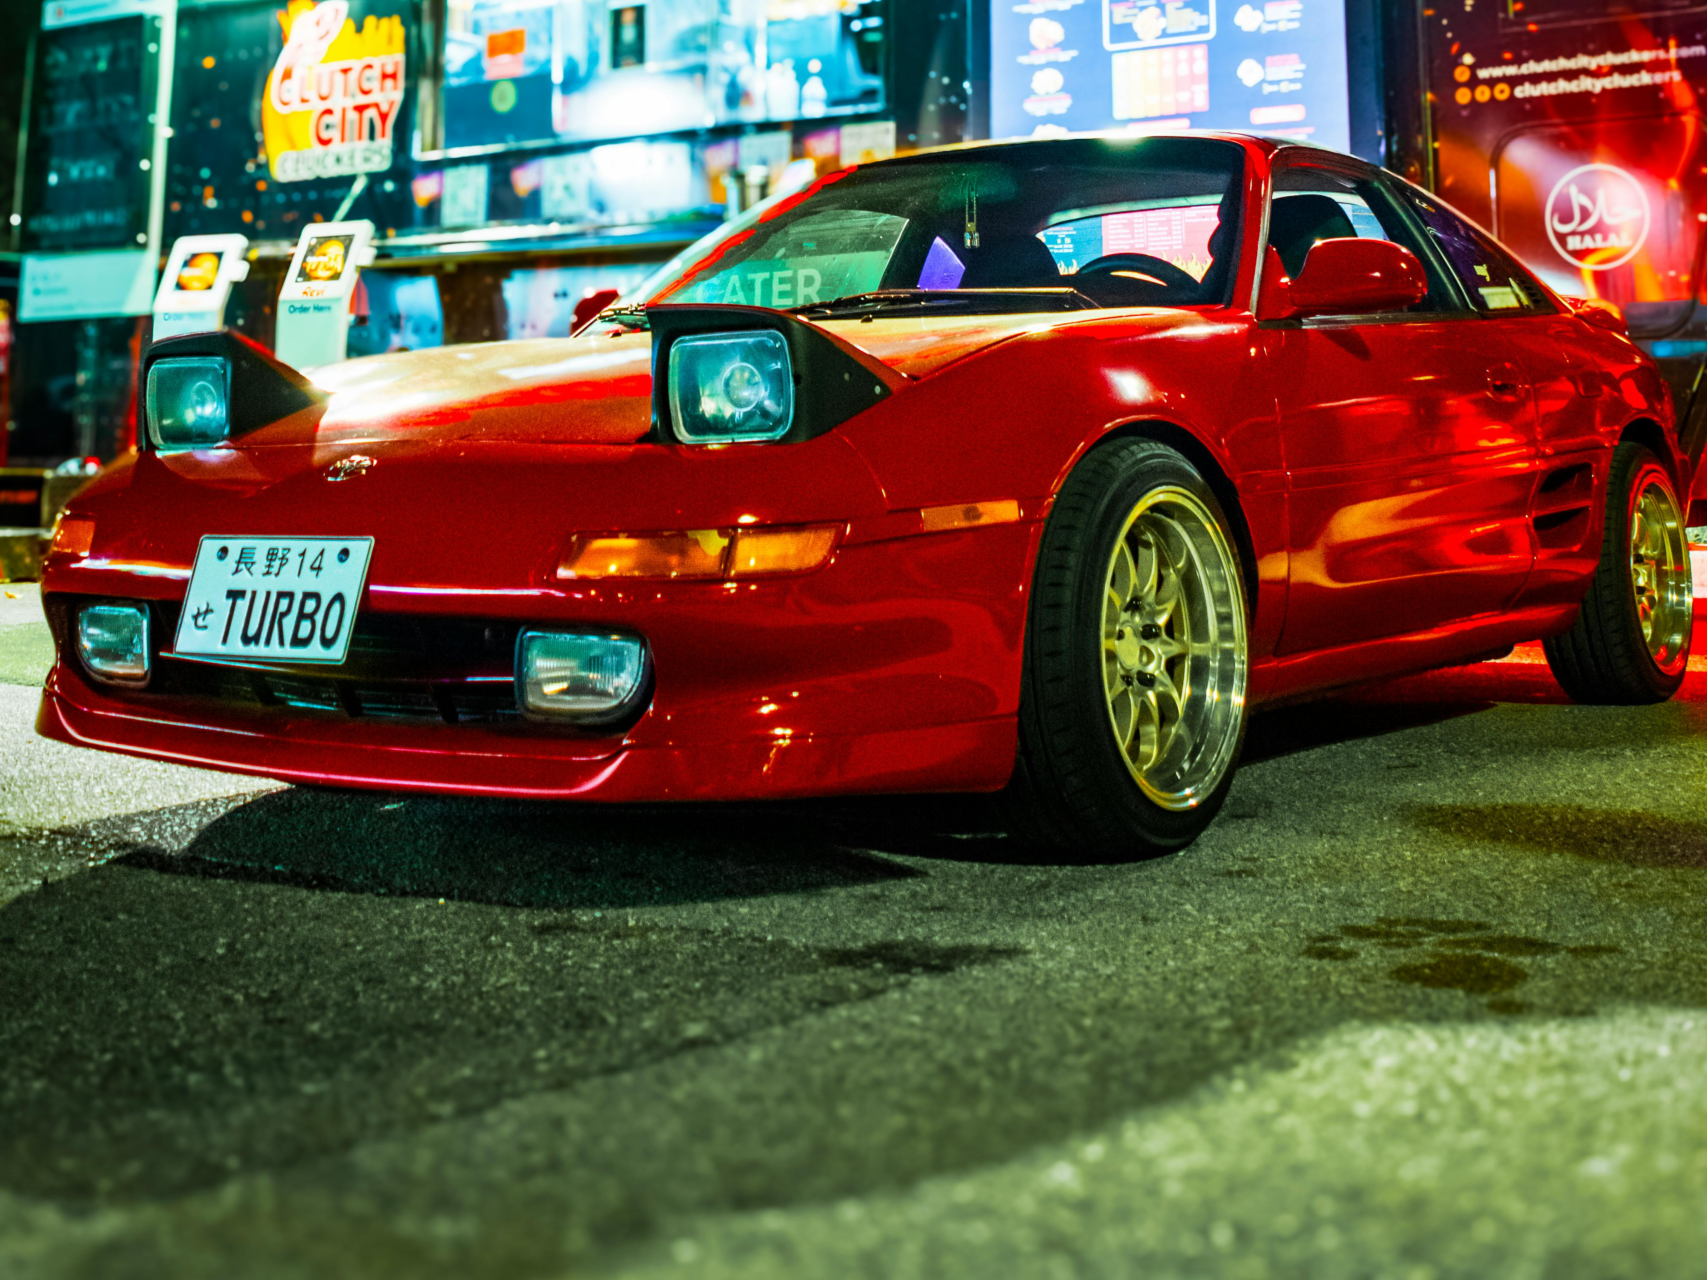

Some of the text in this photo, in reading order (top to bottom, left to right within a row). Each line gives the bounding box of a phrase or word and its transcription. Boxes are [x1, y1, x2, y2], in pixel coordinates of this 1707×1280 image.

[278, 60, 401, 106] CLUTCH
[1476, 45, 1706, 80] www.clutchcitycluckers.com
[1513, 70, 1682, 99] clutchcitycluckers
[315, 100, 396, 147] CITY
[1552, 184, 1642, 234] حلال
[1566, 232, 1633, 251] HALAL
[220, 589, 346, 651] TURBO
